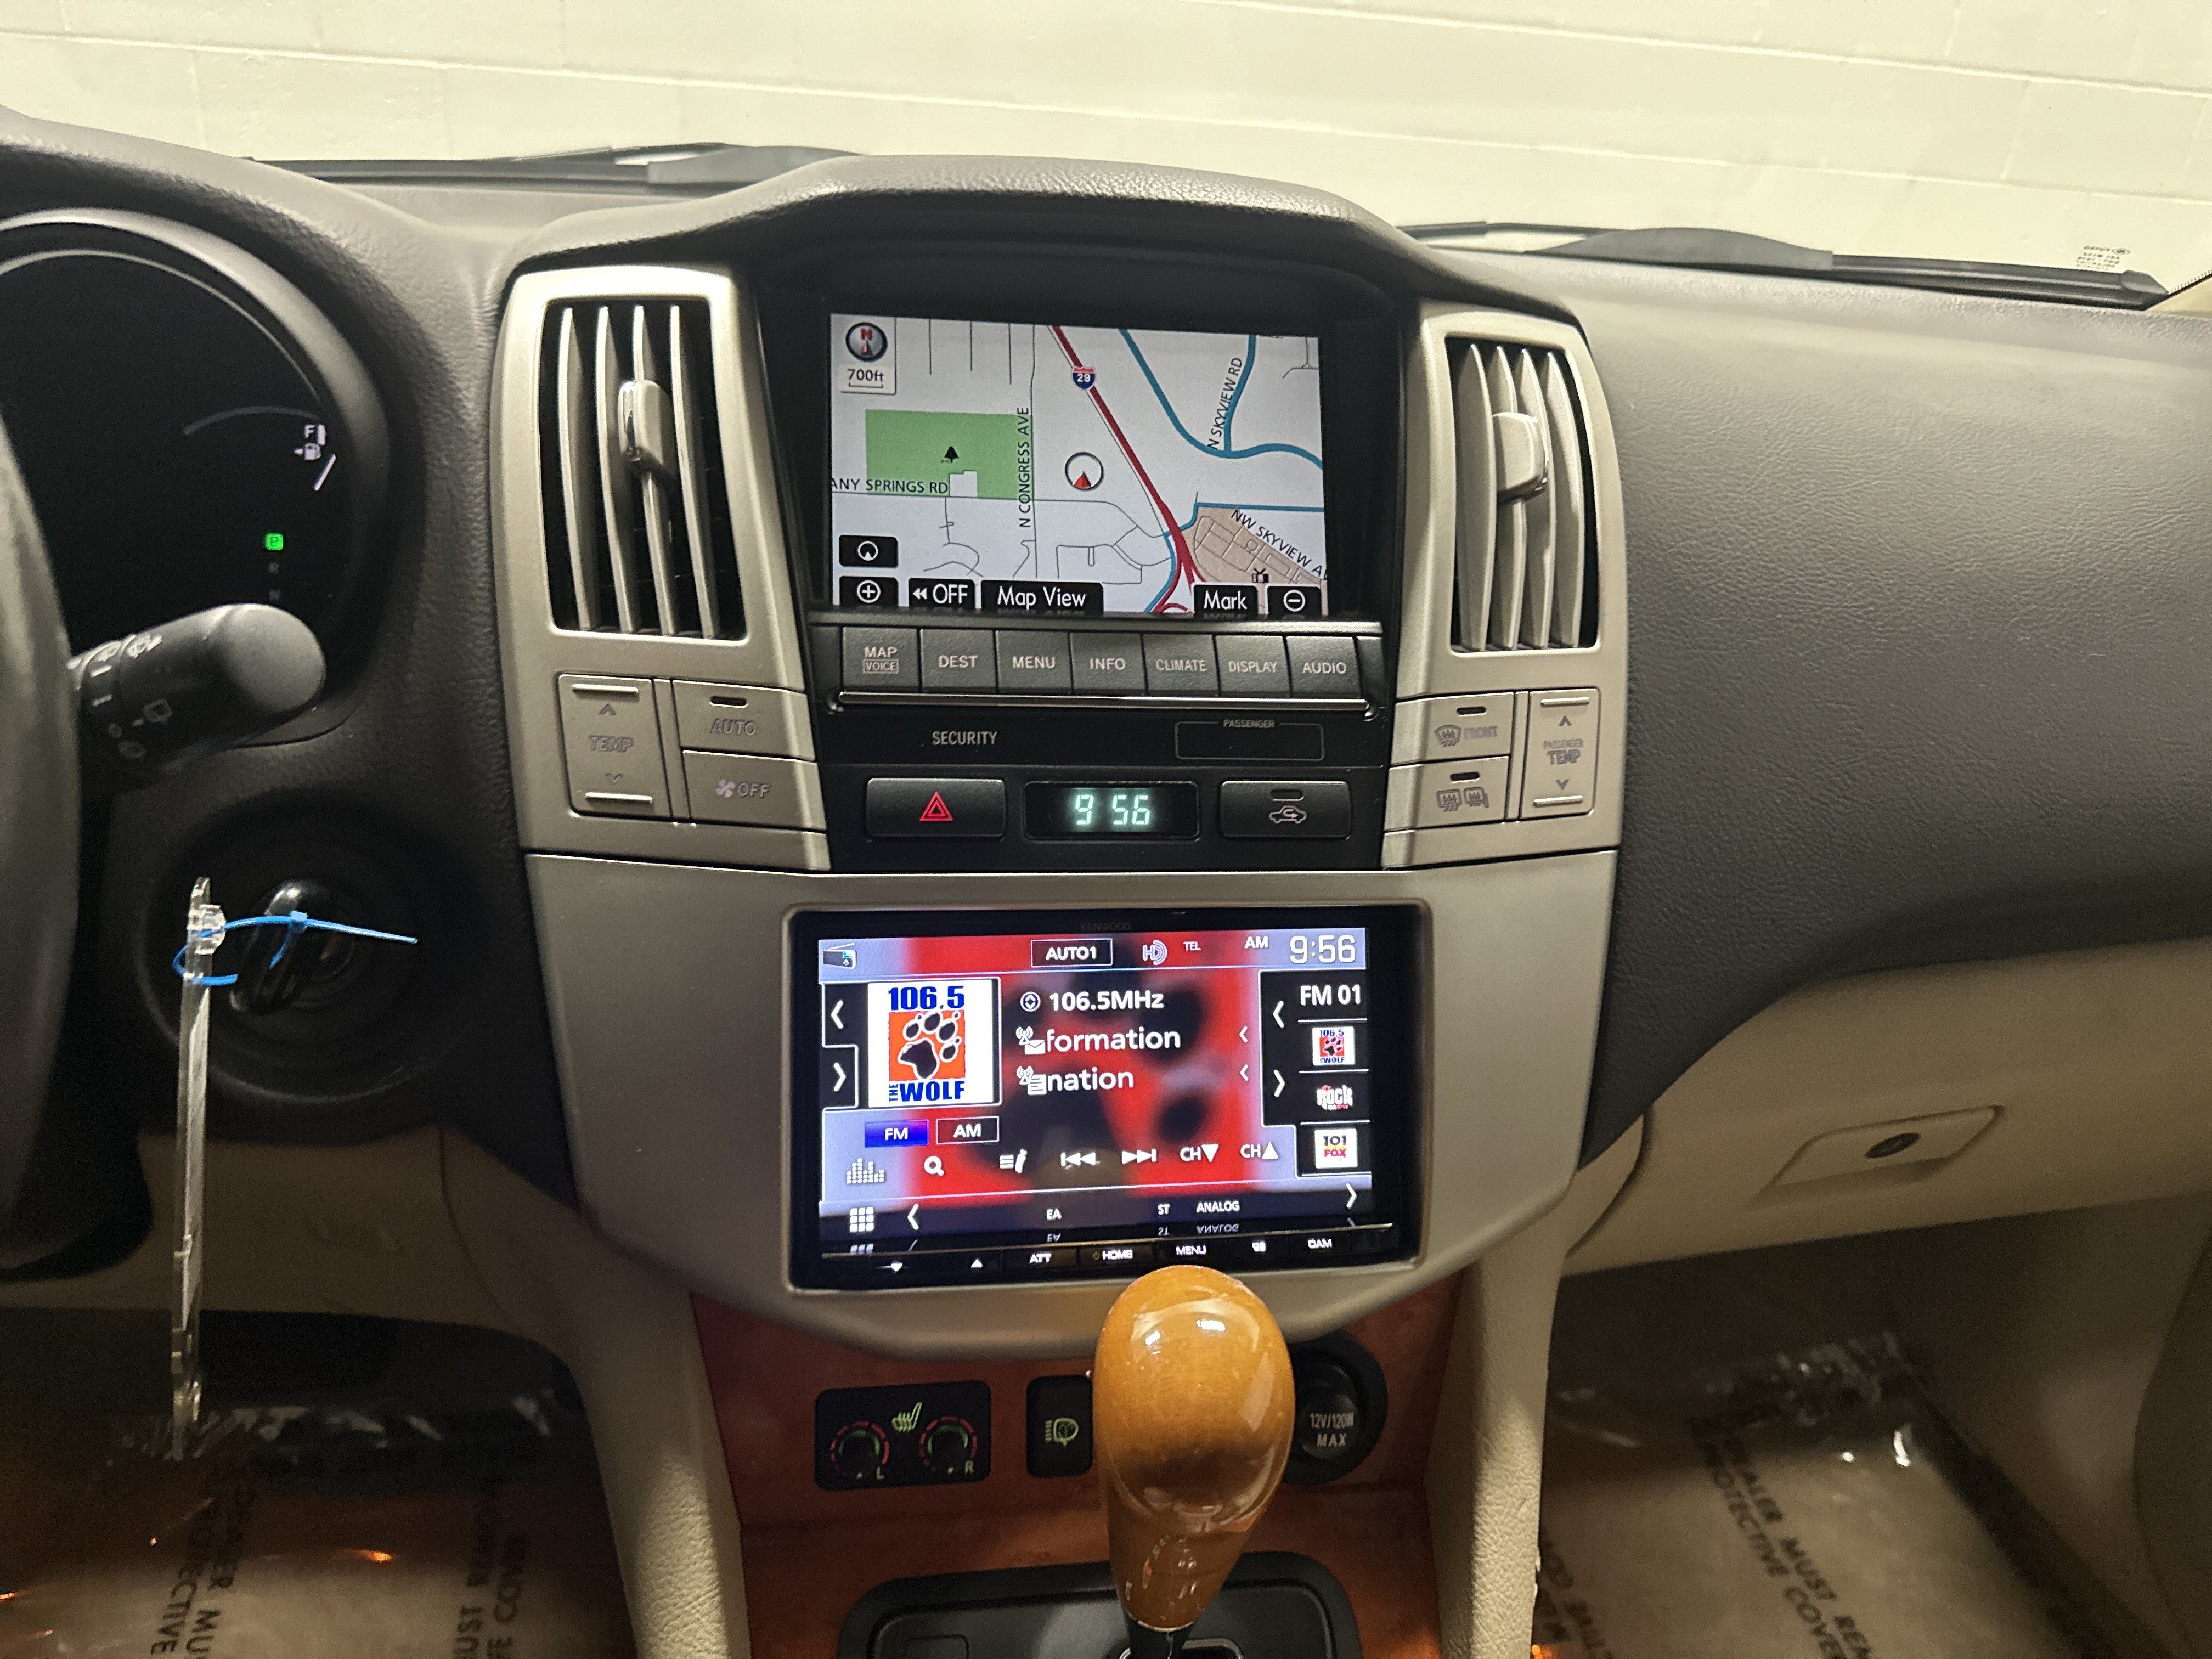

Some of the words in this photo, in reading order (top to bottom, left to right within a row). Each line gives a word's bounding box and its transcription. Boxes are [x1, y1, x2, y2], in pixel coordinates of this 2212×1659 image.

[1228, 358, 1242, 376] RD
[847, 368, 884, 383] 700ft
[1076, 373, 1091, 383] 29
[1211, 377, 1236, 437] SKYVIEW
[1017, 408, 1029, 436] AVE
[304, 424, 317, 439] F
[1207, 438, 1220, 450] N
[1017, 441, 1031, 514] CONGRESS
[830, 478, 860, 491] ANY
[865, 479, 924, 493] SPRINGS
[929, 482, 949, 493] RD
[1019, 518, 1031, 528] N
[1231, 509, 1257, 529] NW
[1255, 526, 1312, 567] SKYVIEW
[933, 583, 968, 604] OFF
[997, 585, 1037, 610] Map
[1042, 586, 1086, 607] View
[1204, 590, 1248, 610] Mark
[864, 646, 898, 658] MAP
[865, 660, 898, 672] VOICE
[939, 655, 978, 669] DEST
[1012, 656, 1056, 669] MENU
[1089, 658, 1126, 671] INFO
[1155, 659, 1207, 672] CLIMATE
[1228, 661, 1277, 673] DISPLAY
[1302, 662, 1347, 675] AUDIO
[710, 718, 757, 736] AUTO
[1223, 719, 1276, 729] PASSENGER
[932, 731, 998, 746] SECURITY
[1463, 726, 1498, 739] FRONT
[589, 735, 634, 752] TEMP
[1543, 738, 1584, 750] PASSENGER
[1547, 749, 1582, 765] TEMP
[737, 782, 770, 798] OFF
[1183, 941, 1201, 951] TEL
[1244, 936, 1269, 949] AM
[1290, 934, 1356, 964] 9:56
[1045, 946, 1097, 961] AUTO1
[888, 985, 965, 1011] 106.5
[1049, 990, 1165, 1012] 106.5MHz
[1300, 984, 1332, 1006] FM
[1337, 984, 1362, 1006] 01
[1046, 1026, 1181, 1052] formation
[1047, 1067, 1134, 1092] nation
[889, 1083, 899, 1102] THE
[900, 1080, 966, 1102] WOLF
[884, 1127, 909, 1141] FM
[953, 1123, 982, 1139] AM
[1180, 1146, 1202, 1161] CH
[1240, 1143, 1261, 1159] CH
[1323, 1149, 1347, 1158] FOX
[1046, 1208, 1062, 1220] EA
[1157, 1203, 1170, 1215] ST
[1196, 1200, 1240, 1213] ANALOG
[1102, 1249, 1133, 1260] HOME
[1176, 1245, 1207, 1255] MENU
[1029, 1253, 1052, 1263] ATT
[1317, 1432, 1347, 1447] MAX
[875, 1467, 885, 1480] L
[964, 1460, 974, 1474] R
